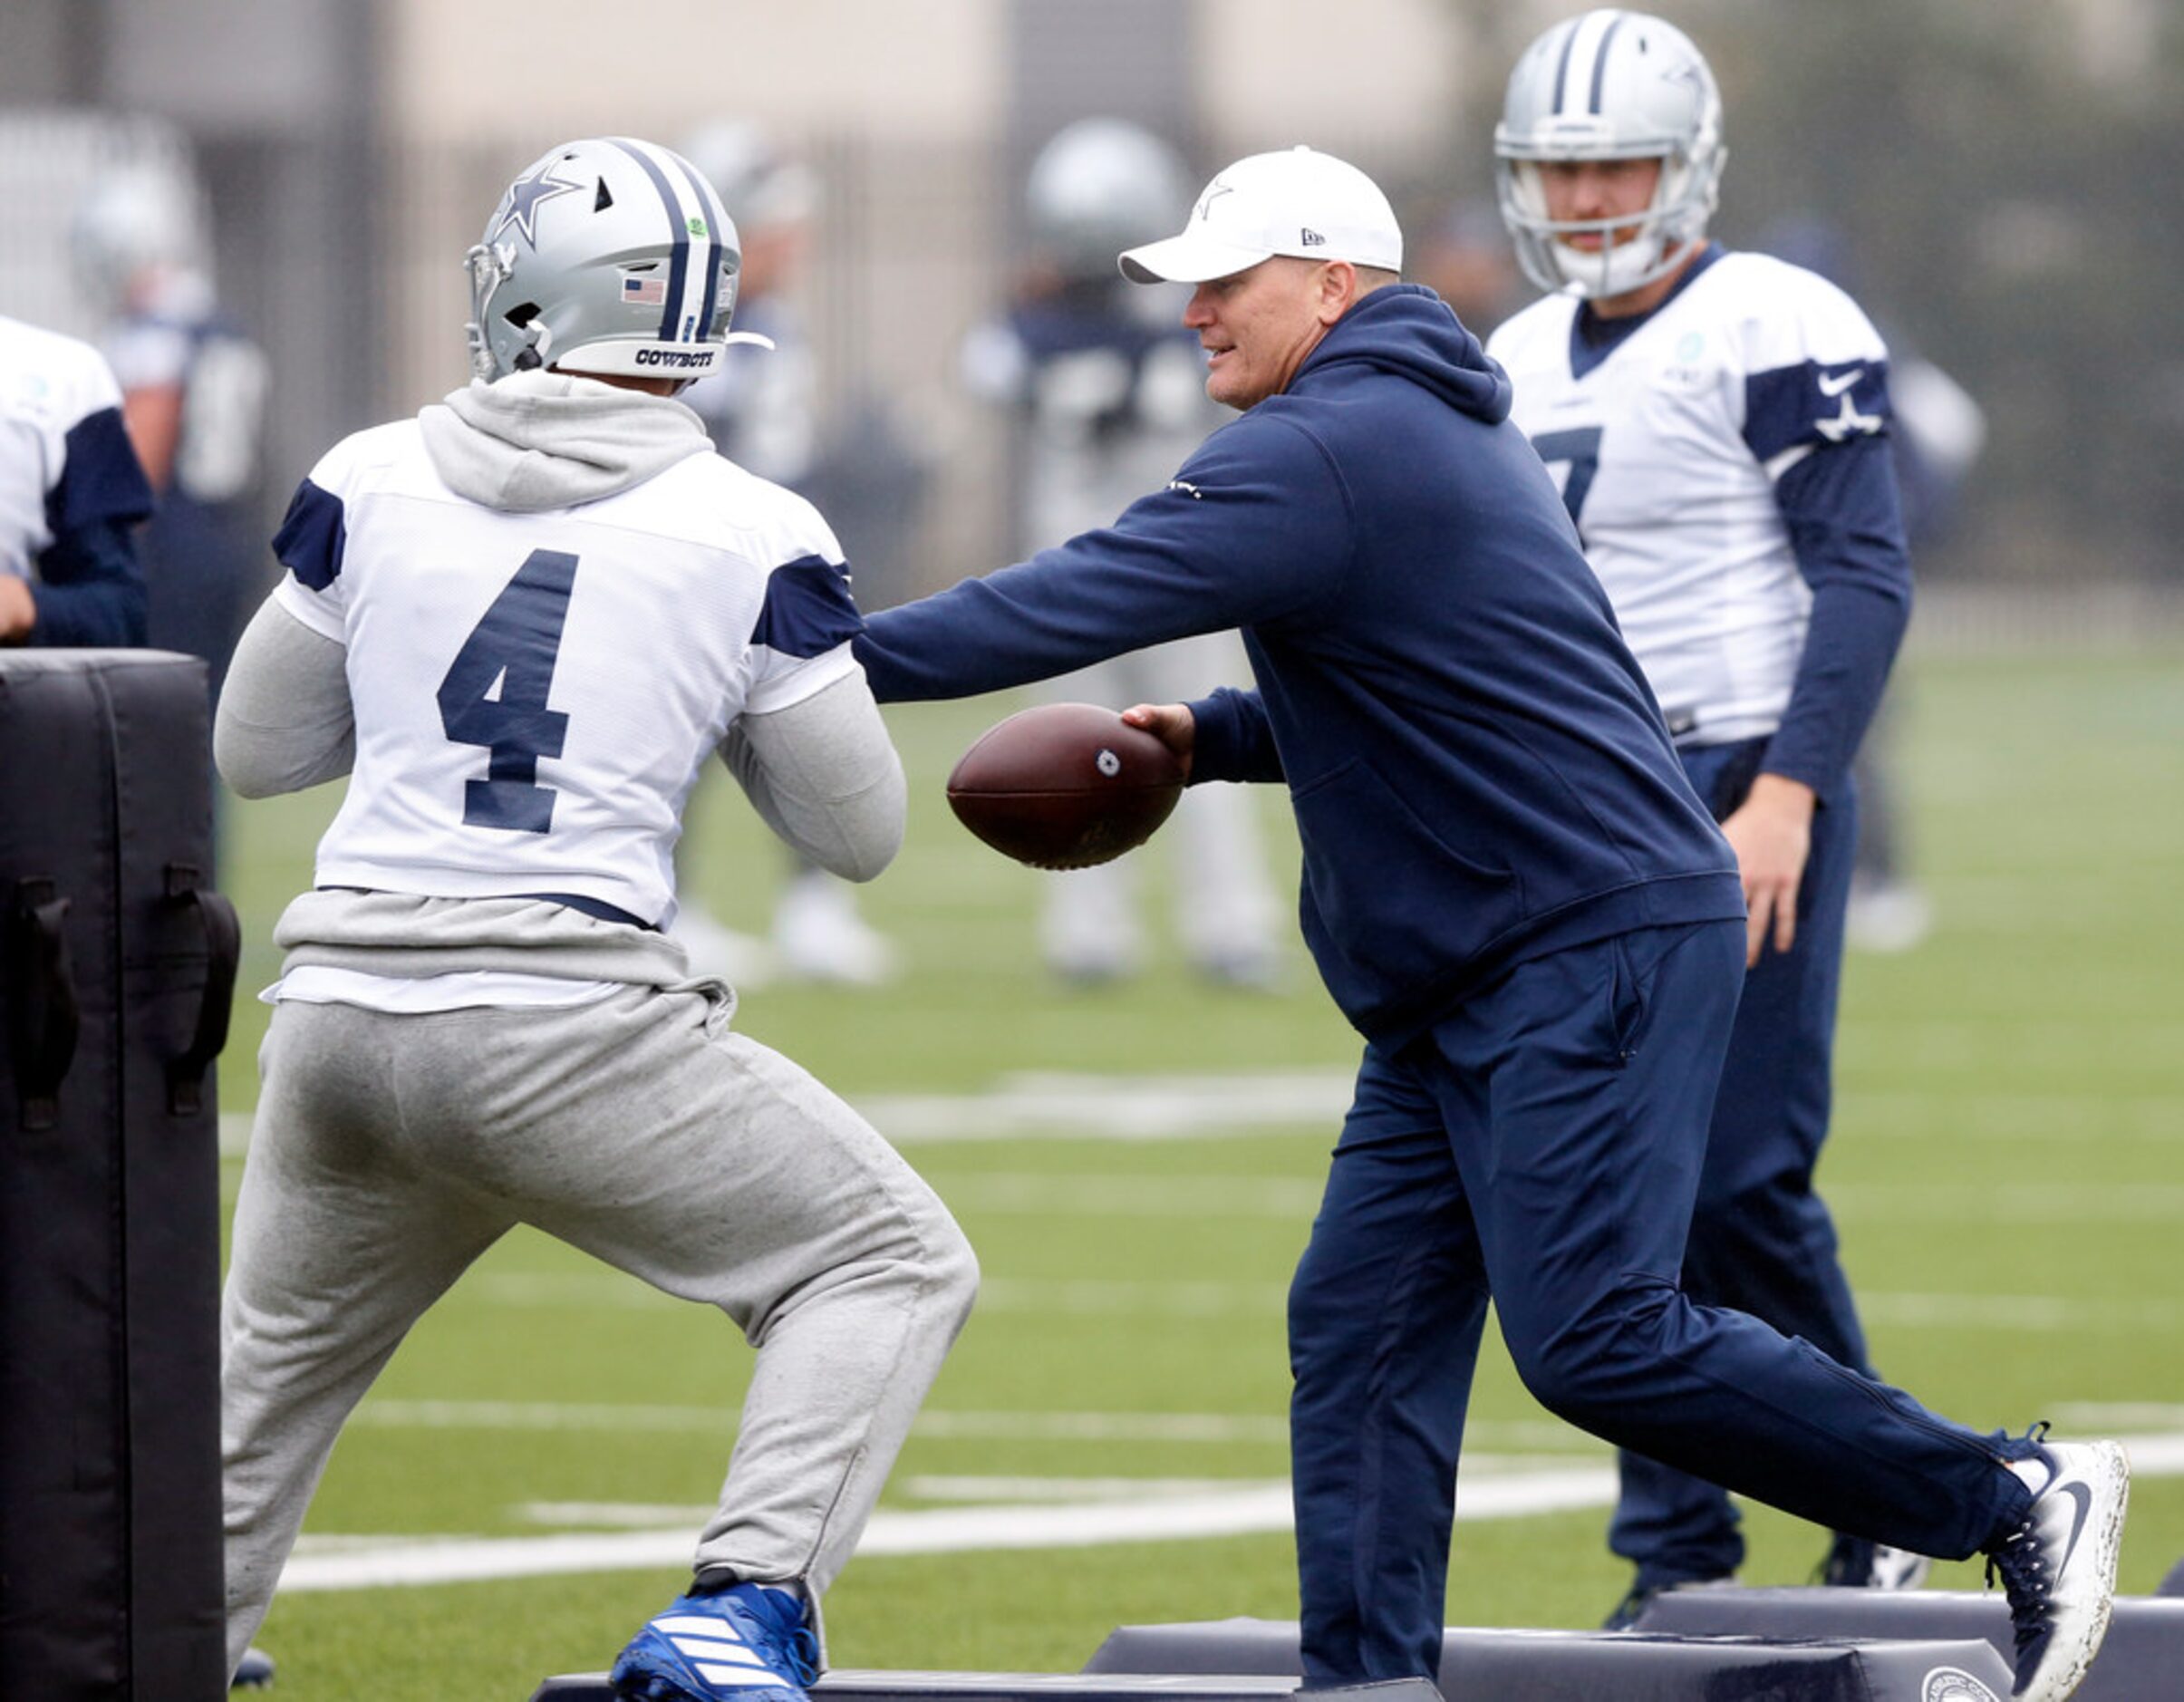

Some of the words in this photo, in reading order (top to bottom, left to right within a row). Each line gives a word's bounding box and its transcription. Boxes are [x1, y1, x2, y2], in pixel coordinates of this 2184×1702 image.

[635, 349, 714, 367] COWBOYS
[1530, 425, 1603, 528] 7
[437, 548, 580, 834] 4
